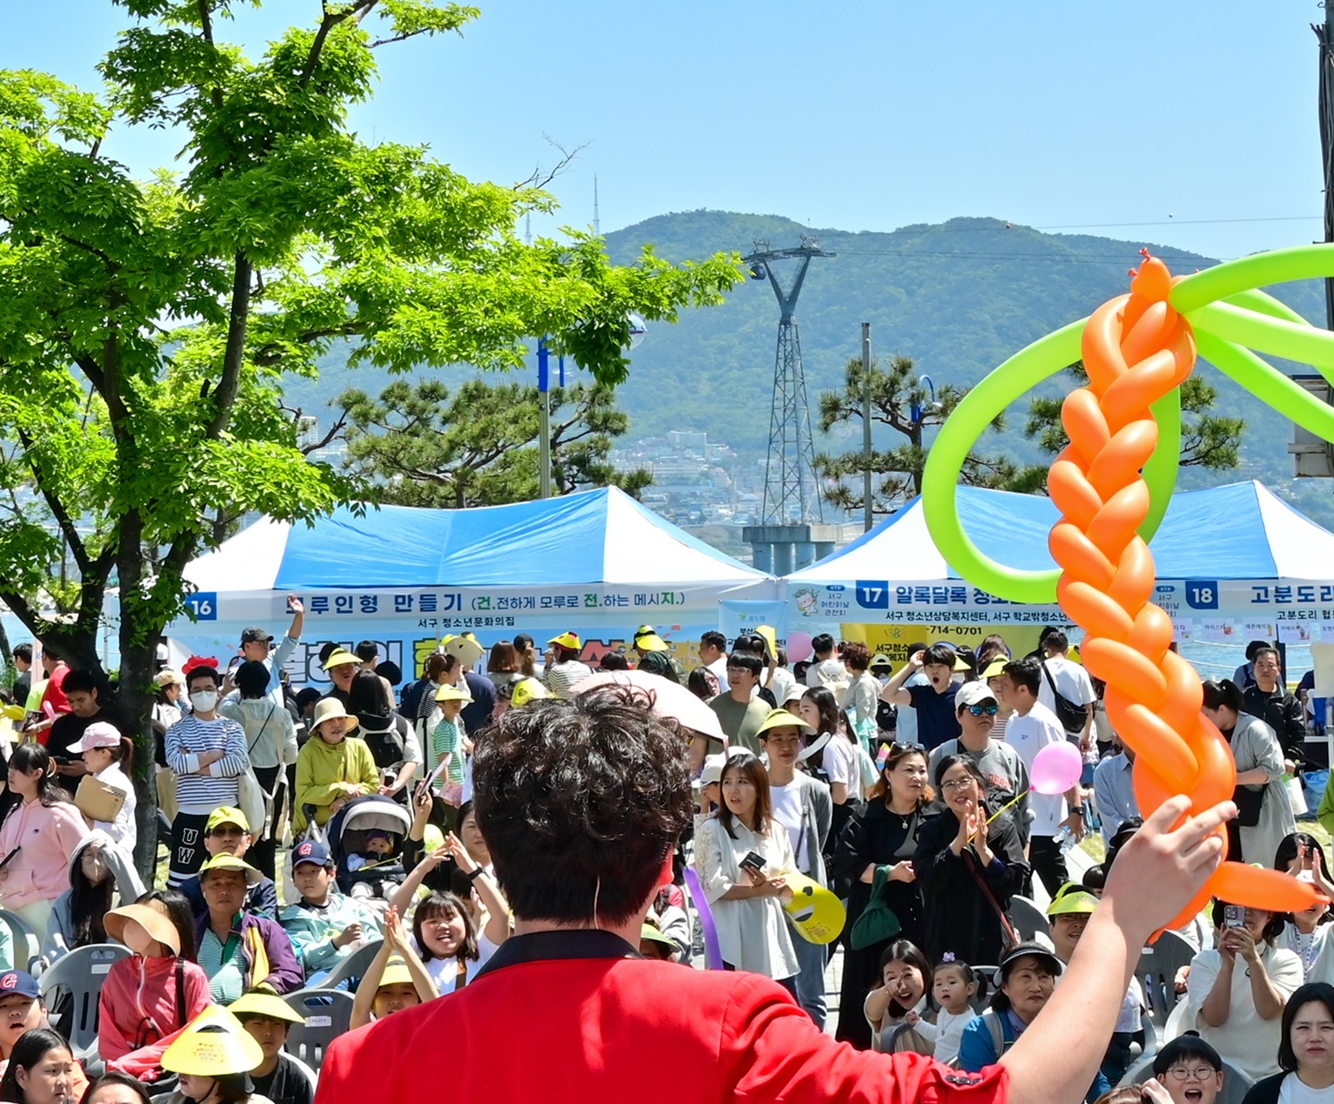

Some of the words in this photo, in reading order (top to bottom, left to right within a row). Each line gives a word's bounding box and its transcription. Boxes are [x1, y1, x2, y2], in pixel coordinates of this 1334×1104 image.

[863, 587, 882, 603] 17
[896, 586, 966, 605] 알록달록
[1192, 588, 1213, 603] 18
[191, 600, 212, 615] 16
[394, 593, 462, 613] 만들기
[540, 596, 579, 609] 모루로
[584, 593, 630, 608] 전.하는
[418, 618, 439, 628] 서구
[442, 616, 515, 628] 청소년문화의집
[885, 611, 903, 622] 서구
[993, 611, 1011, 621] 서구
[1013, 611, 1070, 622] 학교밖청소년
[1277, 610, 1317, 620] 고분도리
[876, 643, 911, 653] 서구청소
